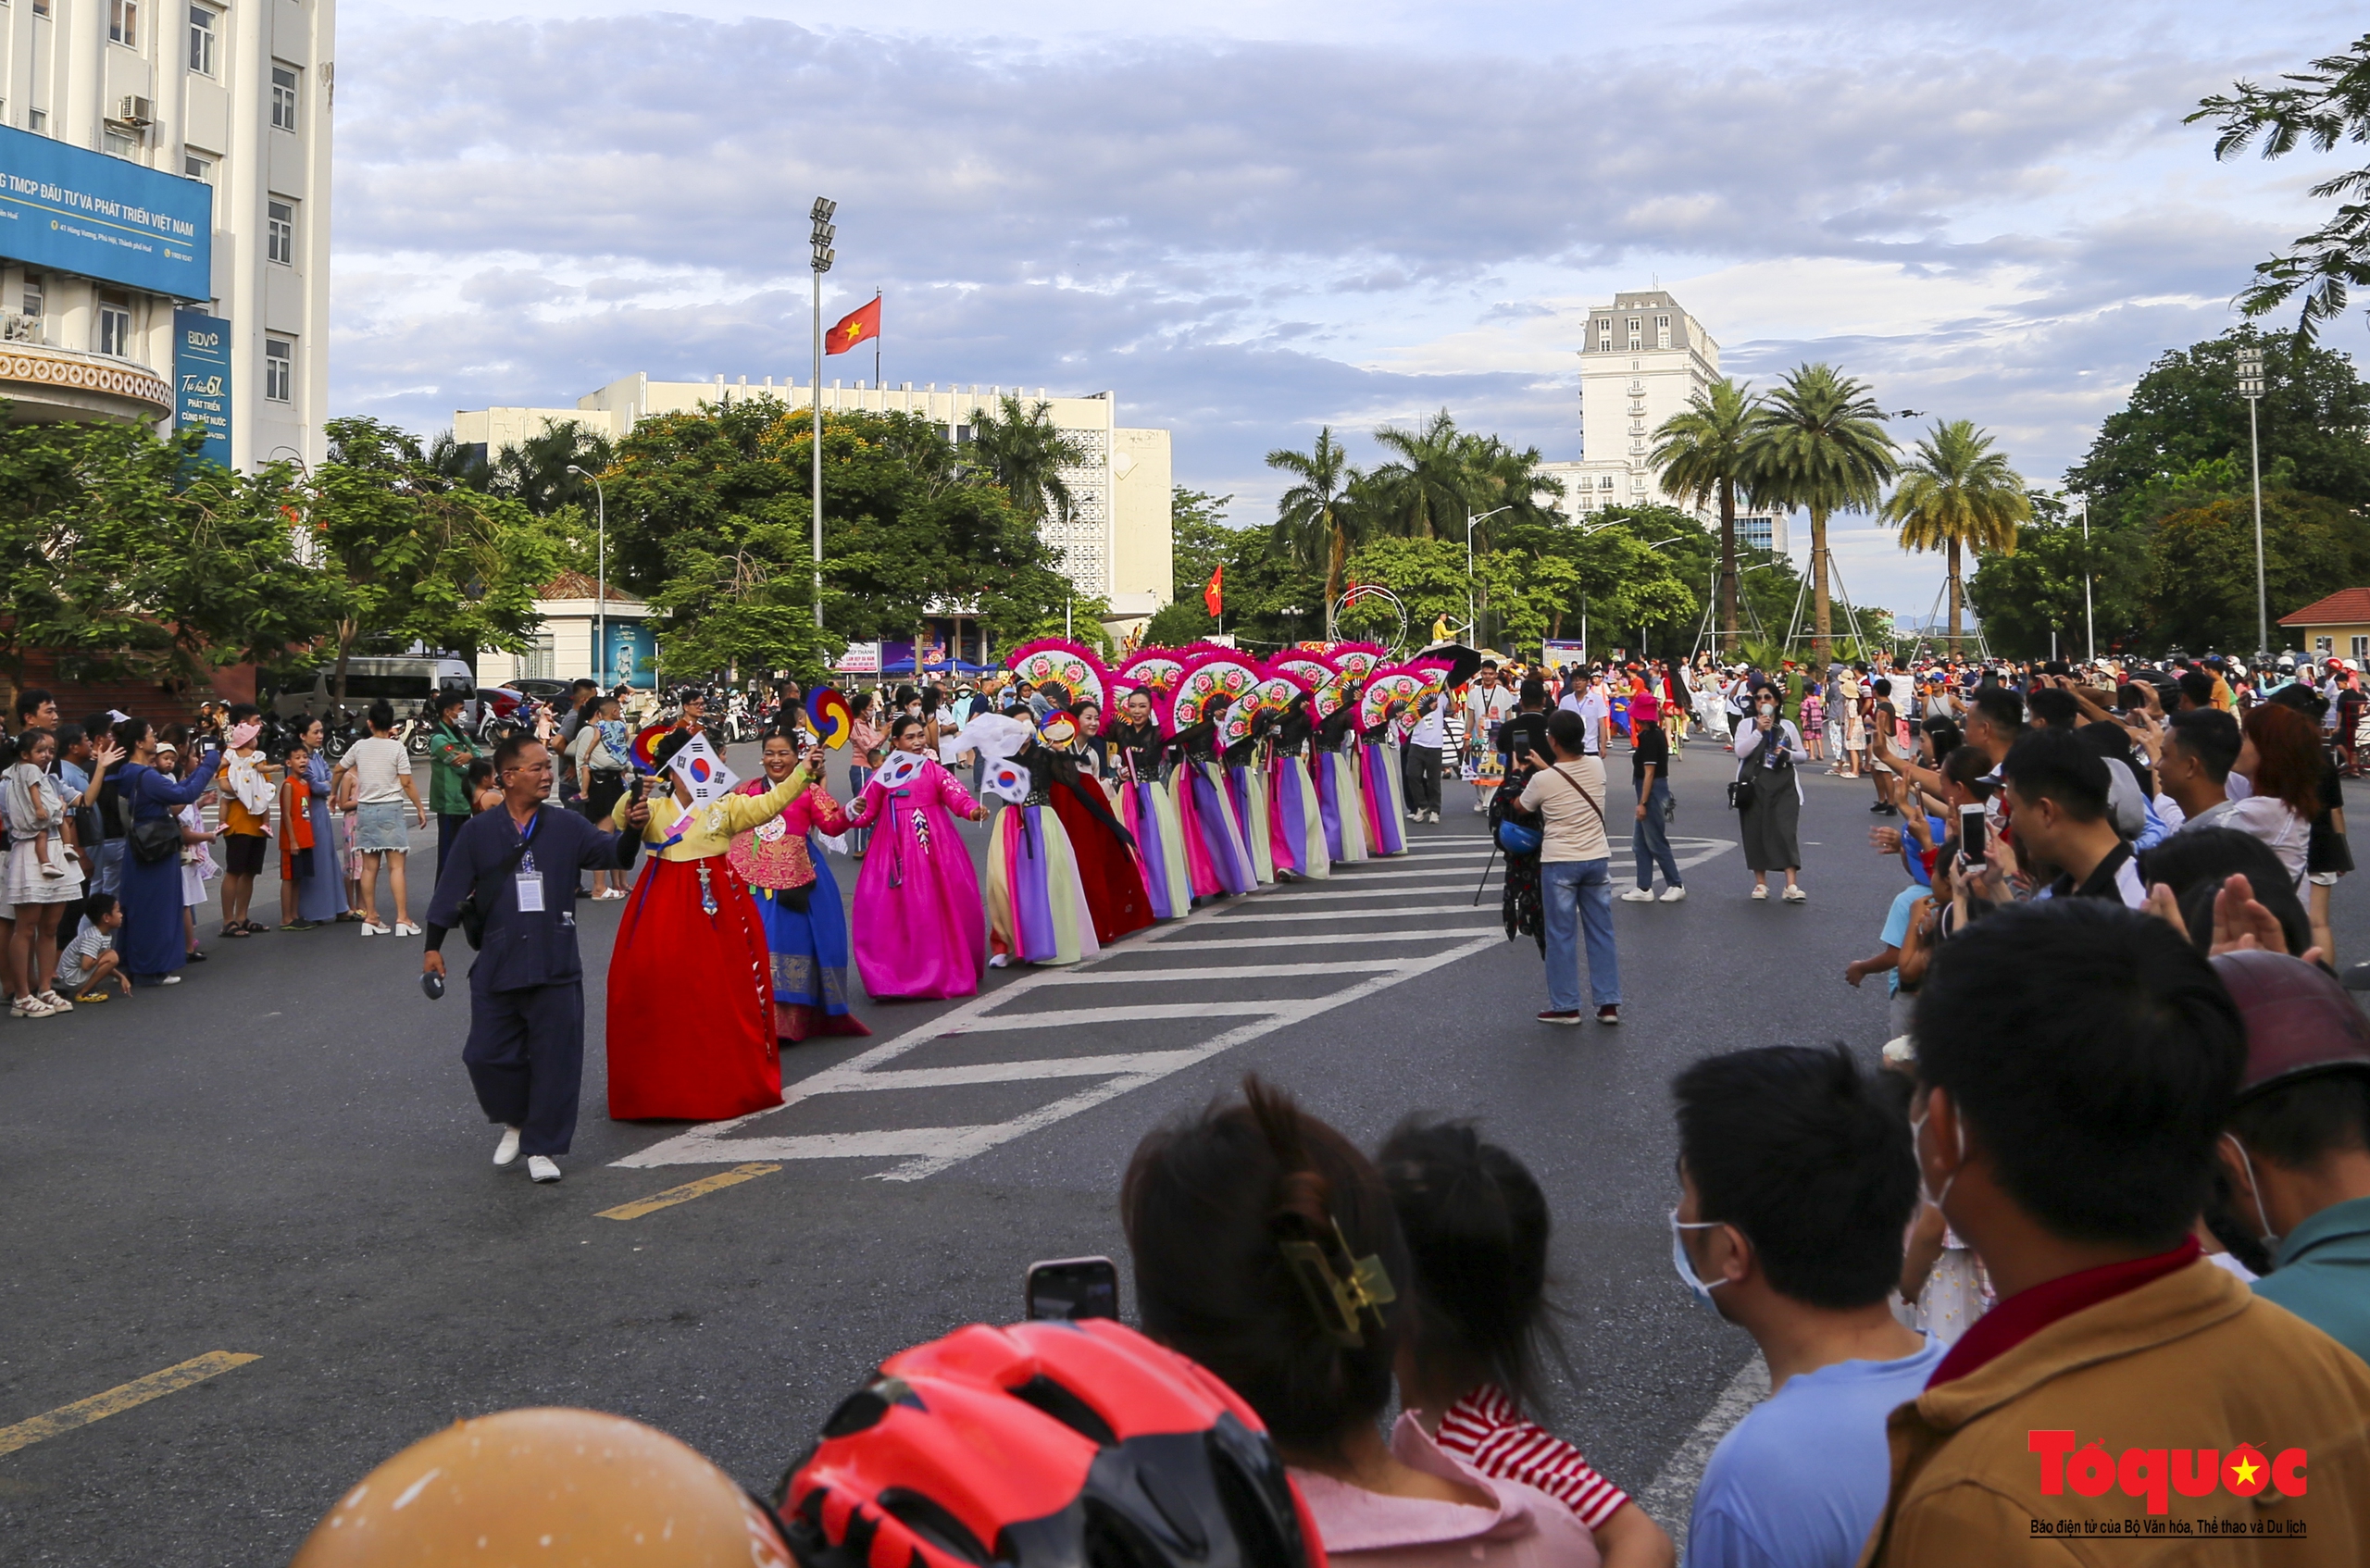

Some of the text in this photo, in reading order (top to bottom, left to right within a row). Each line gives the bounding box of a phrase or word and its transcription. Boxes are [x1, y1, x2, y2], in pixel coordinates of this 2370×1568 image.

[8, 175, 39, 195] TMCP
[40, 183, 62, 202] ĐẦU
[63, 189, 80, 206] TƯ
[80, 193, 94, 211] VÀ
[94, 198, 120, 218] PHÁT
[122, 205, 149, 226] TRIỂN
[151, 213, 171, 231] VIỆT
[172, 218, 193, 237] NAM
[188, 330, 210, 347] BIDV
[206, 375, 223, 395] 67
[188, 398, 221, 412] PHÁT TRIỂN
[181, 410, 198, 422] CÙNG
[210, 416, 227, 427] NƯỚC
